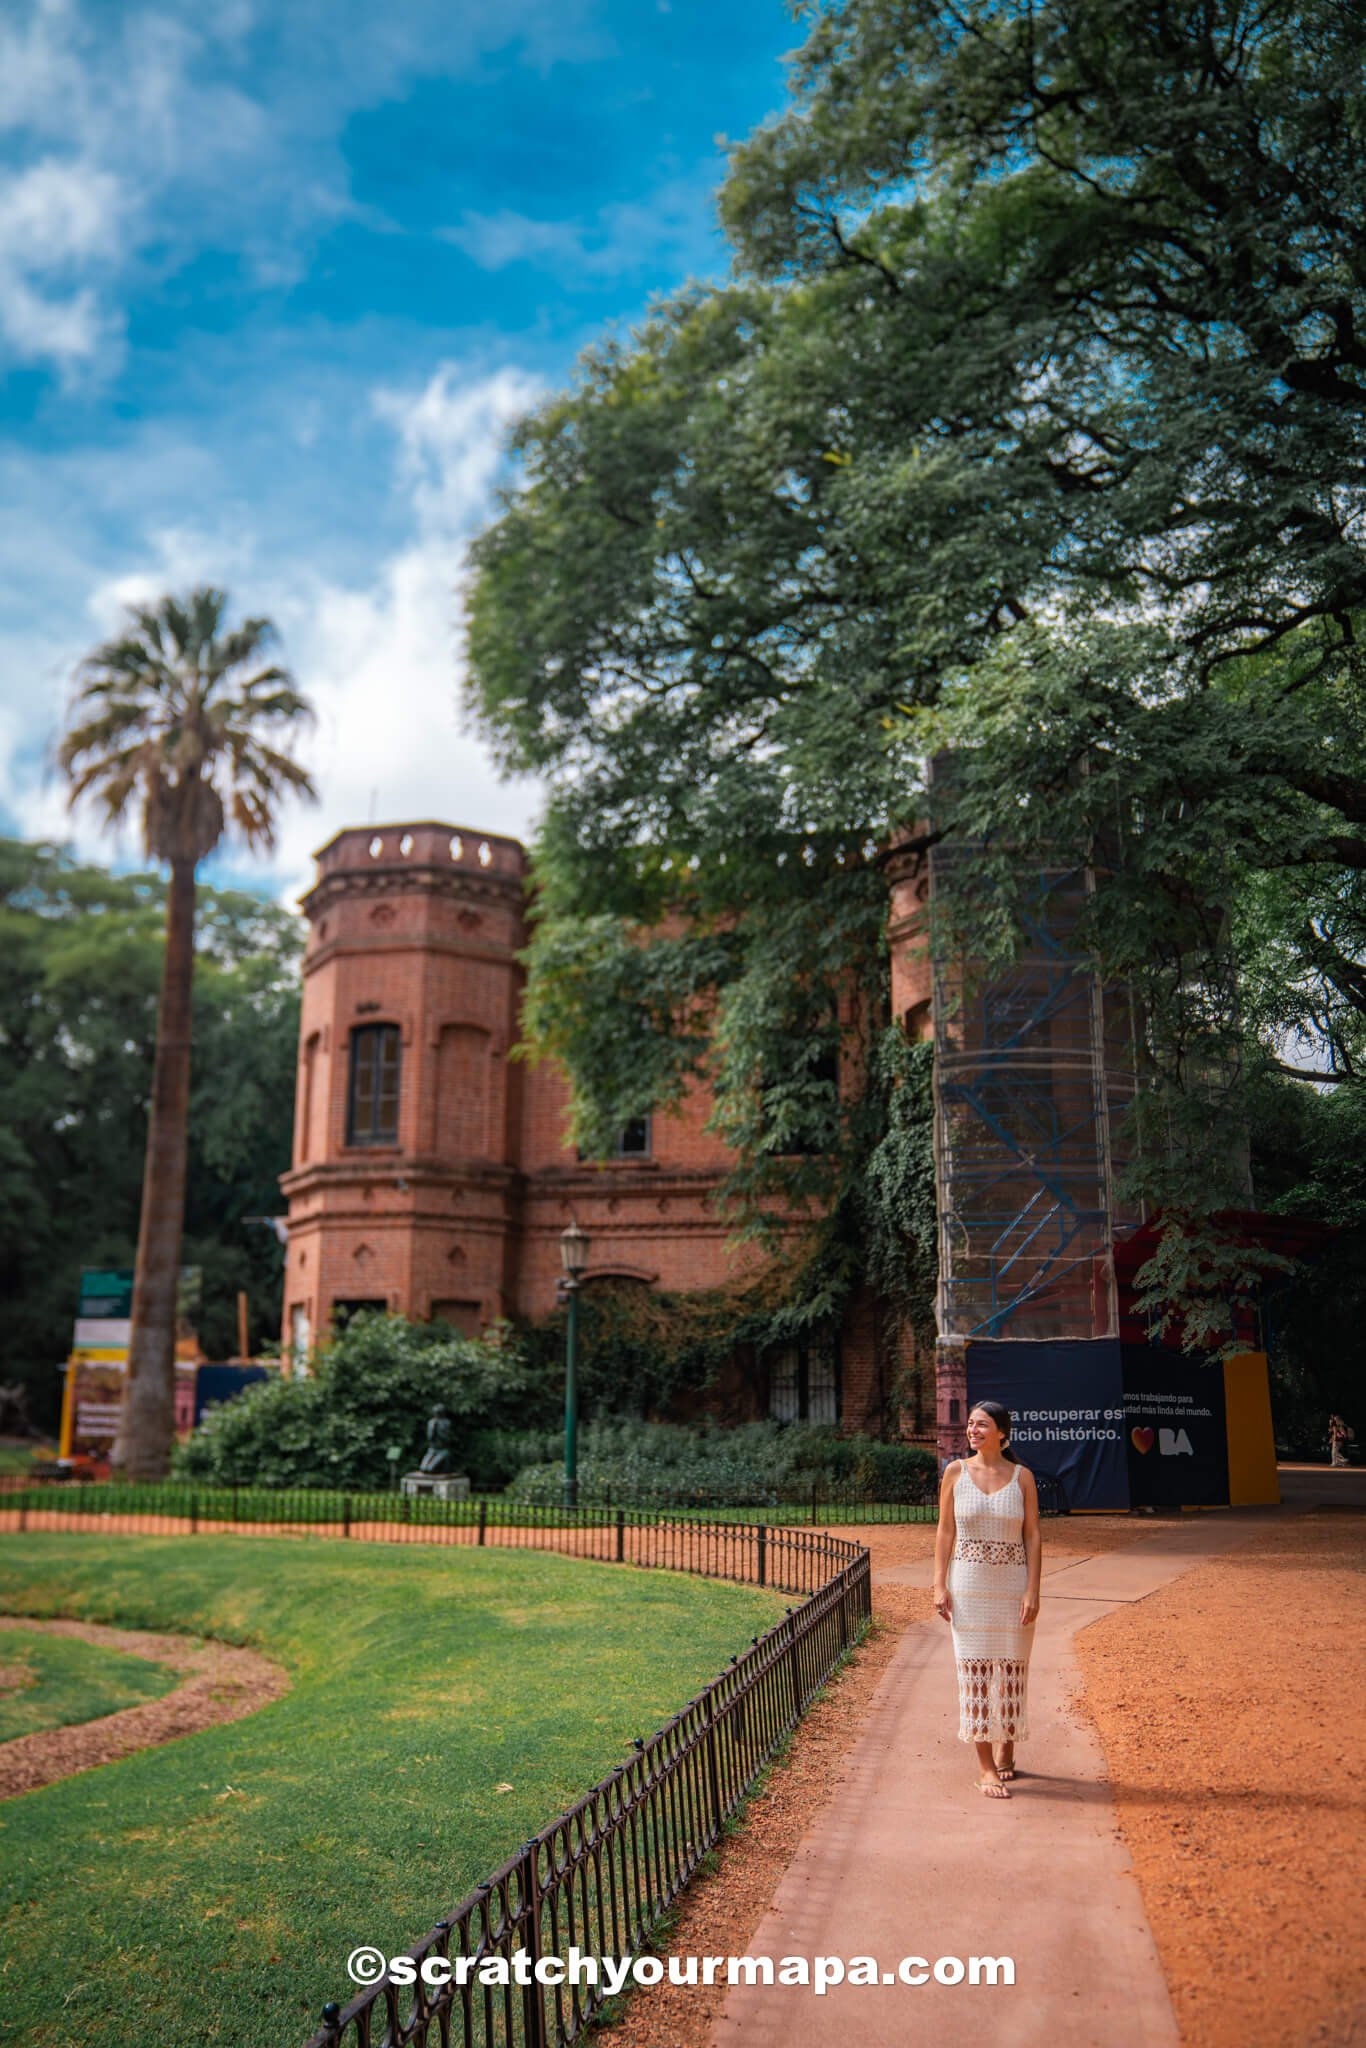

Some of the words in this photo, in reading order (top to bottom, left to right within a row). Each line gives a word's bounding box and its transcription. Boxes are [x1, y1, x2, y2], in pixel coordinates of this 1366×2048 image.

[1140, 1392, 1177, 1403] trabajando
[1178, 1395, 1193, 1404] para
[1023, 1409, 1101, 1424] recuperar
[1142, 1405, 1156, 1414] más
[1157, 1406, 1174, 1415] linda
[1175, 1407, 1185, 1415] del
[1186, 1408, 1213, 1416] mundo.
[1045, 1426, 1121, 1441] histórico.
[1158, 1428, 1194, 1456] BA
